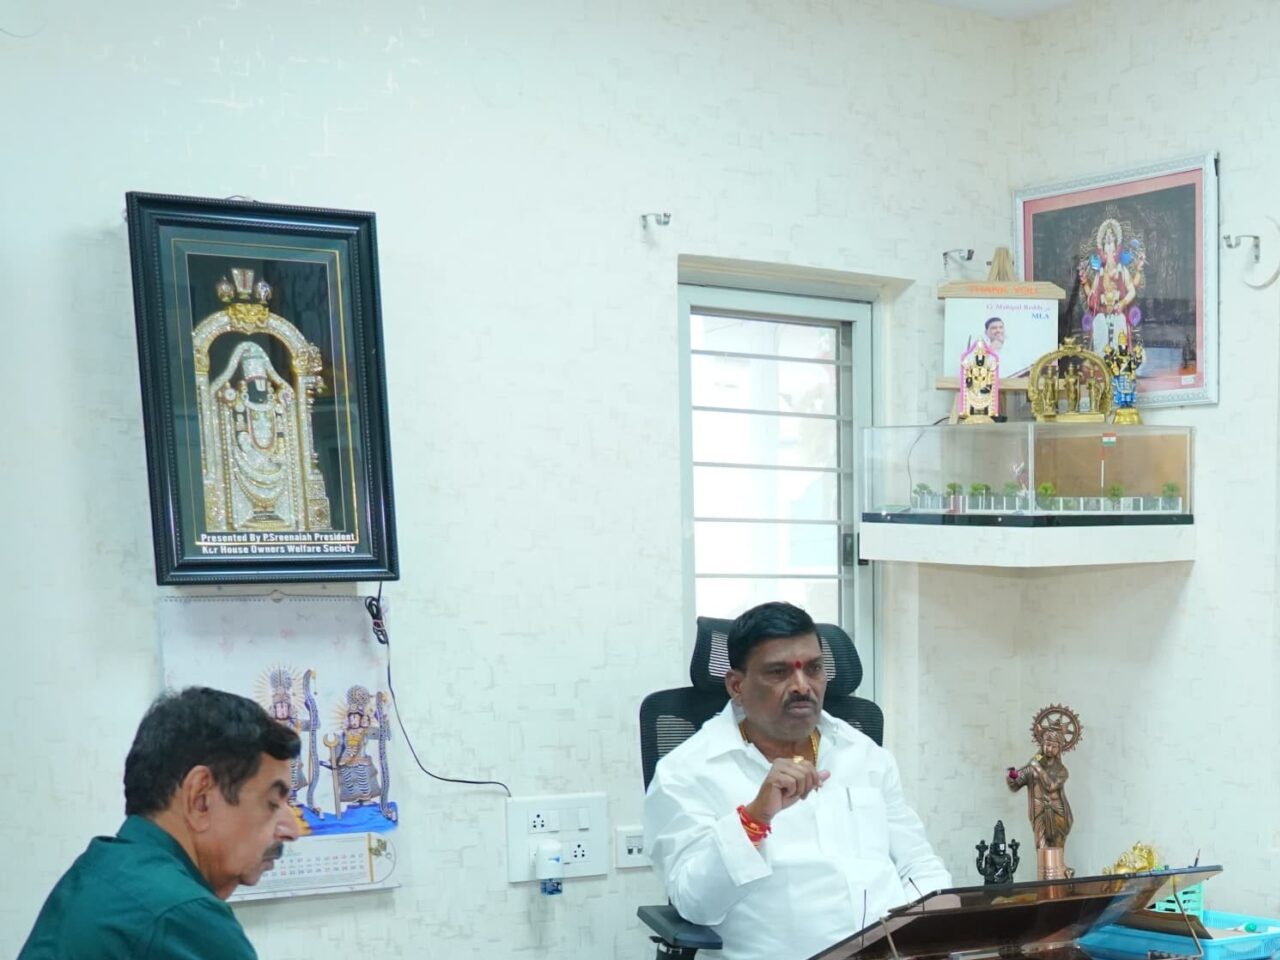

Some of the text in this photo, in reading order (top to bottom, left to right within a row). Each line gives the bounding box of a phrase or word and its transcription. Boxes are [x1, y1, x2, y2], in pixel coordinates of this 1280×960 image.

[1031, 312, 1050, 320] MLA
[200, 533, 248, 543] Presented
[250, 533, 261, 543] By
[314, 532, 355, 541] President
[220, 545, 249, 554] House
[252, 544, 286, 553] Owners
[287, 544, 321, 553] Welfare
[322, 543, 355, 553] Society
